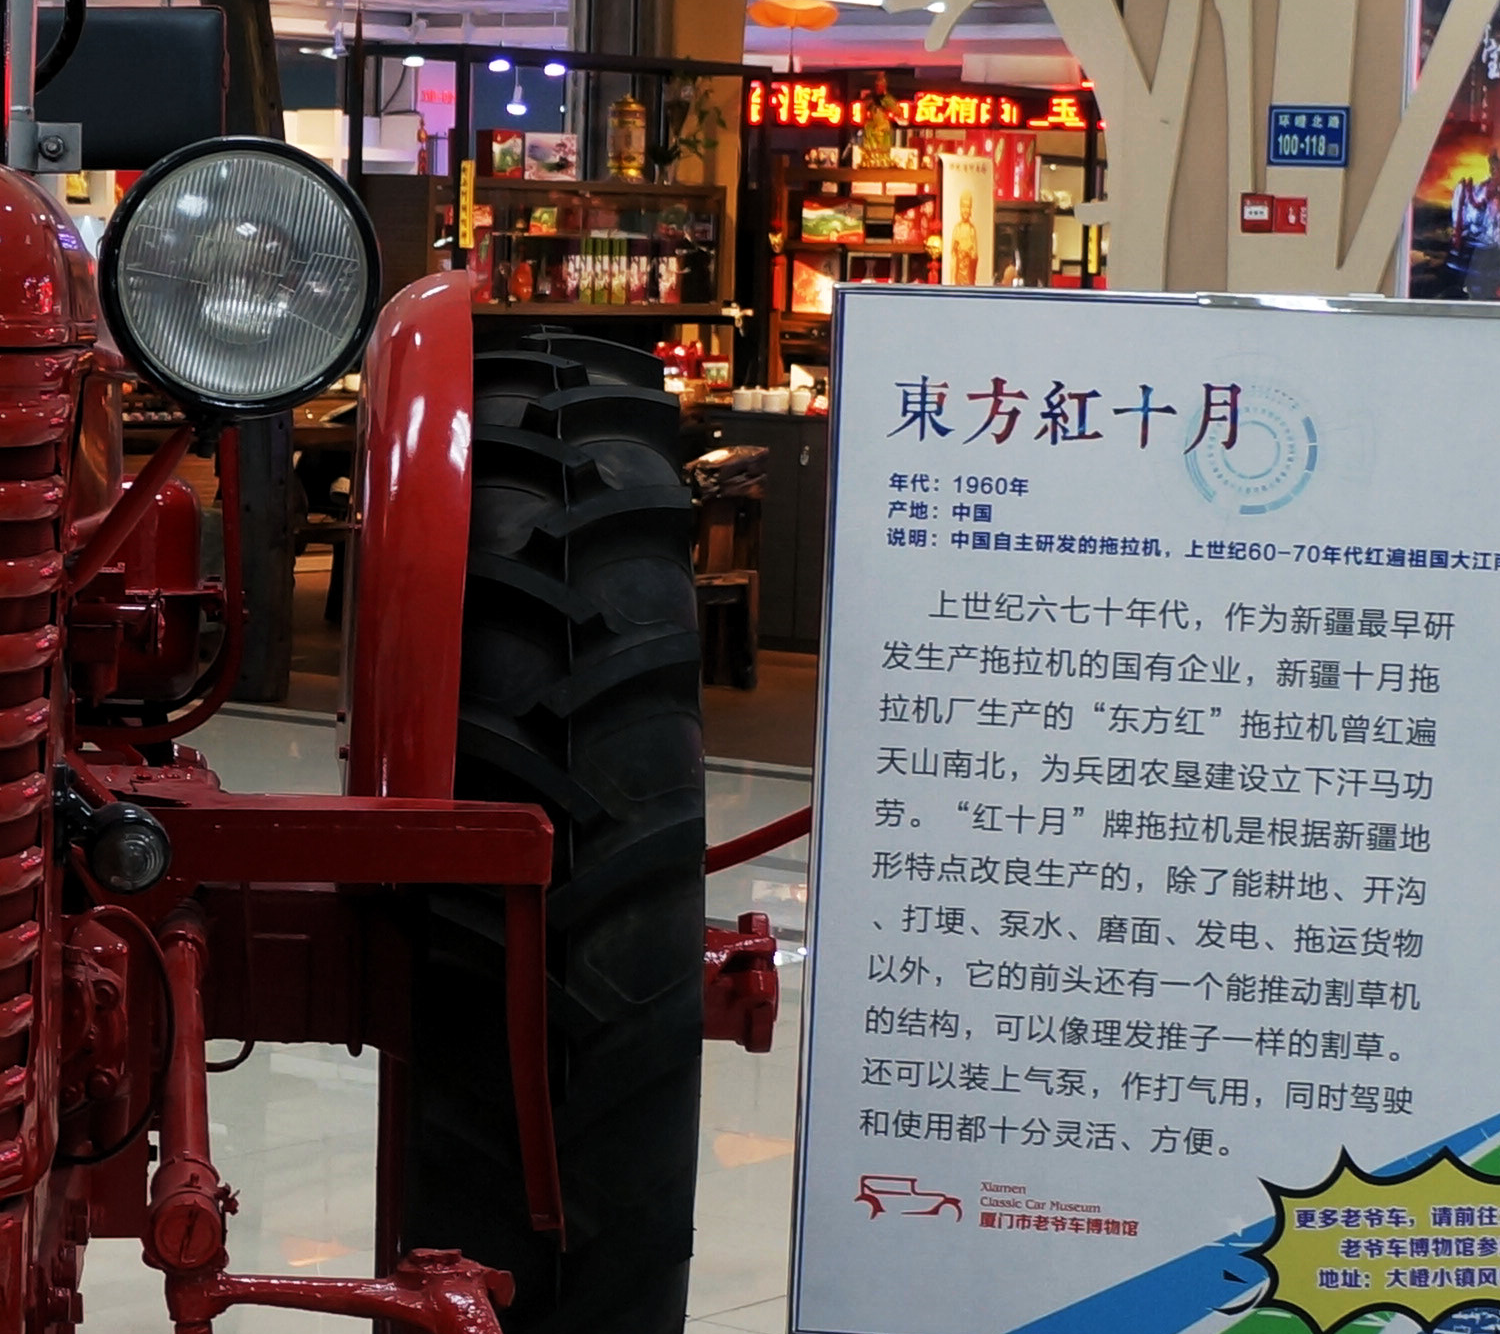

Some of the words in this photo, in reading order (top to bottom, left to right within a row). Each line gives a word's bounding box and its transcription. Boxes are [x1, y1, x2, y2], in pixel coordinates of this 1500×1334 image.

[886, 375, 1243, 455] 東方紅十月
[979, 1196, 1022, 1210] Classic
[1026, 1199, 1046, 1210] Car
[1049, 1200, 1102, 1214] Museum
[979, 1211, 1140, 1238] 厦门市老爷车博物馆
